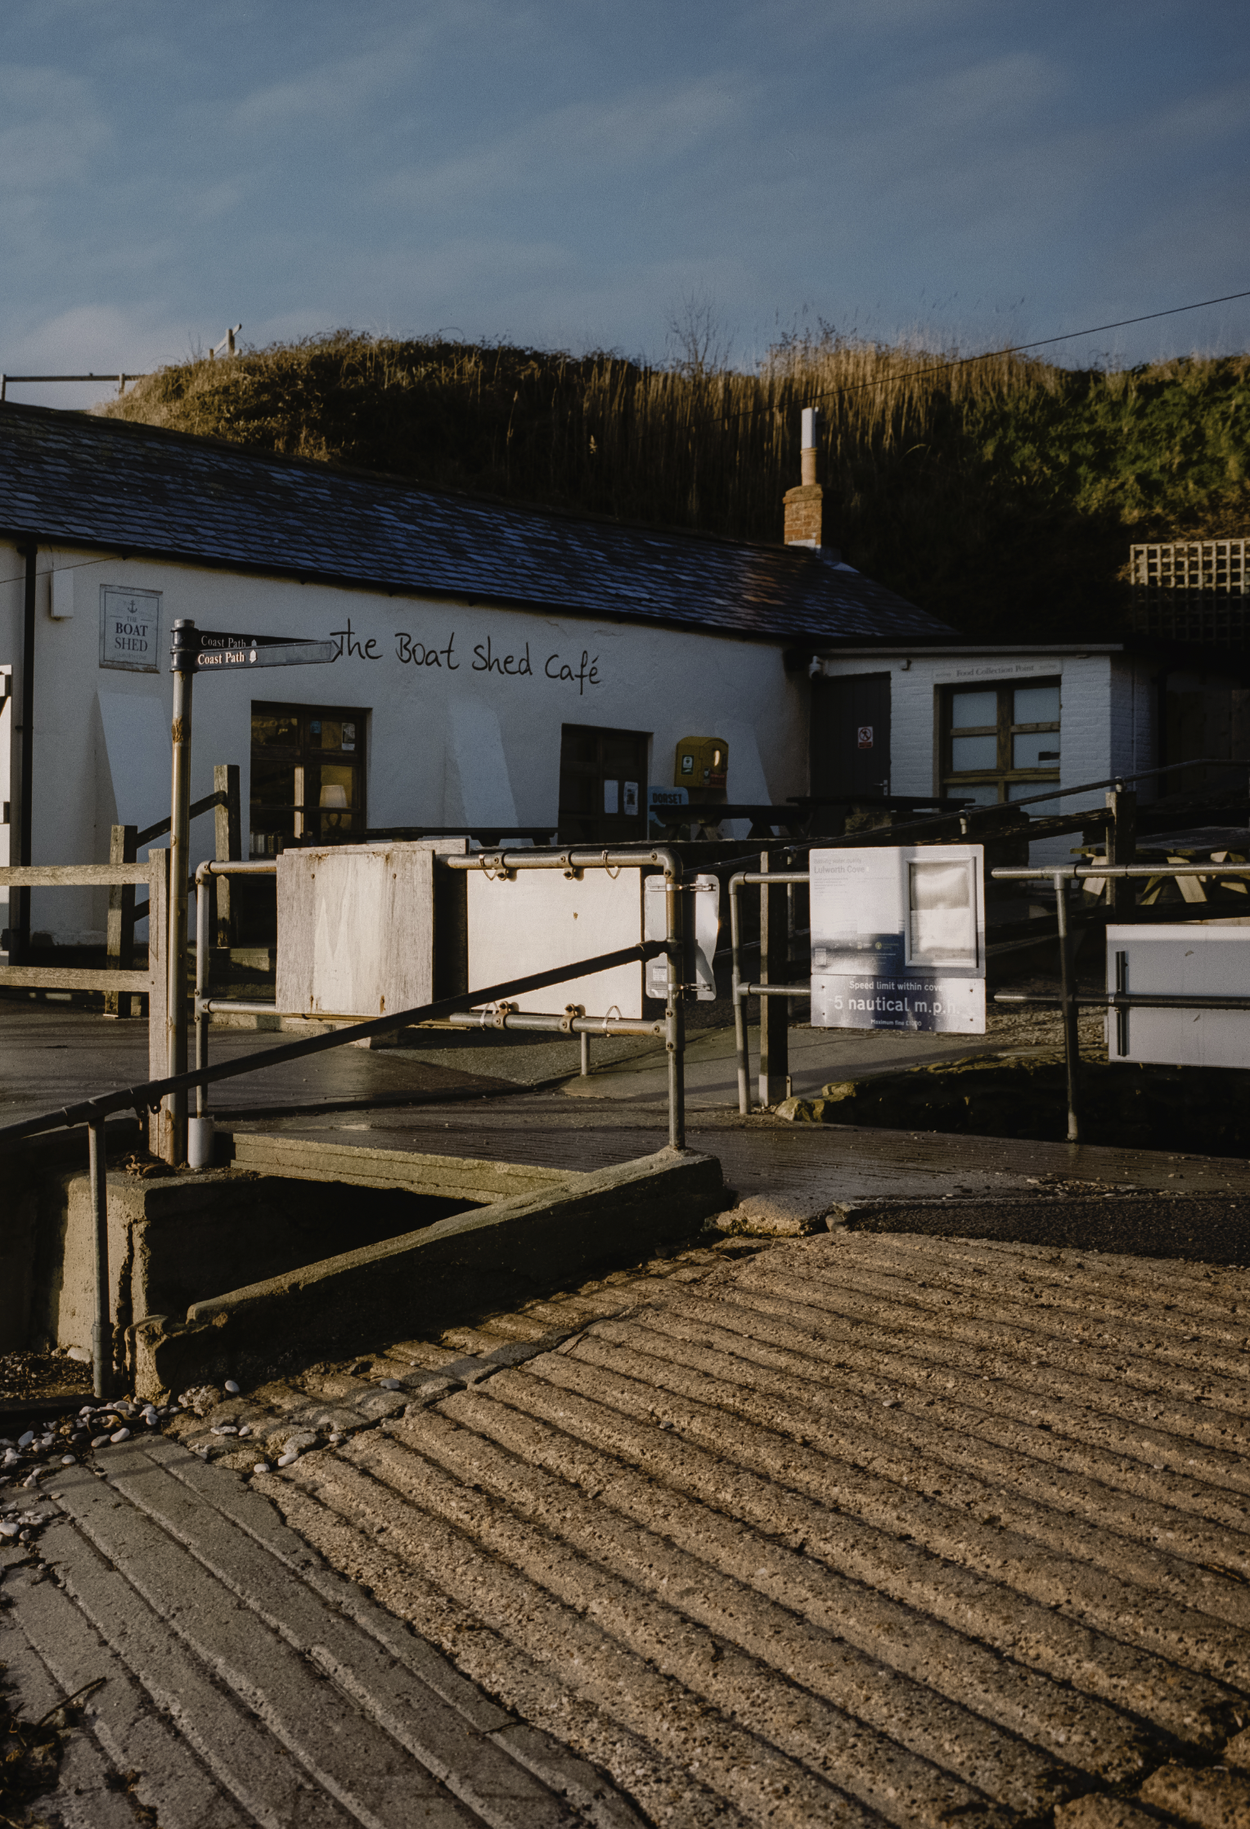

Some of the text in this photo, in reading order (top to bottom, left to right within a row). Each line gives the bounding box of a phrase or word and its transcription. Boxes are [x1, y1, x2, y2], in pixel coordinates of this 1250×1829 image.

[115, 622, 148, 637] BOAT
[114, 637, 148, 652] SHED
[201, 635, 247, 648] Coast Path
[197, 651, 246, 665] Coast Path
[329, 618, 601, 695] The Boat Shed Café
[956, 669, 974, 677] Food
[975, 667, 1014, 676] Collection
[1015, 664, 1035, 672] Point
[652, 793, 682, 804] DORSET
[814, 865, 865, 874] Lulworth Cove
[849, 981, 874, 990] Speed
[876, 981, 895, 990] limit
[897, 982, 922, 991] within
[834, 995, 843, 1010] 5
[848, 996, 910, 1012] nautical
